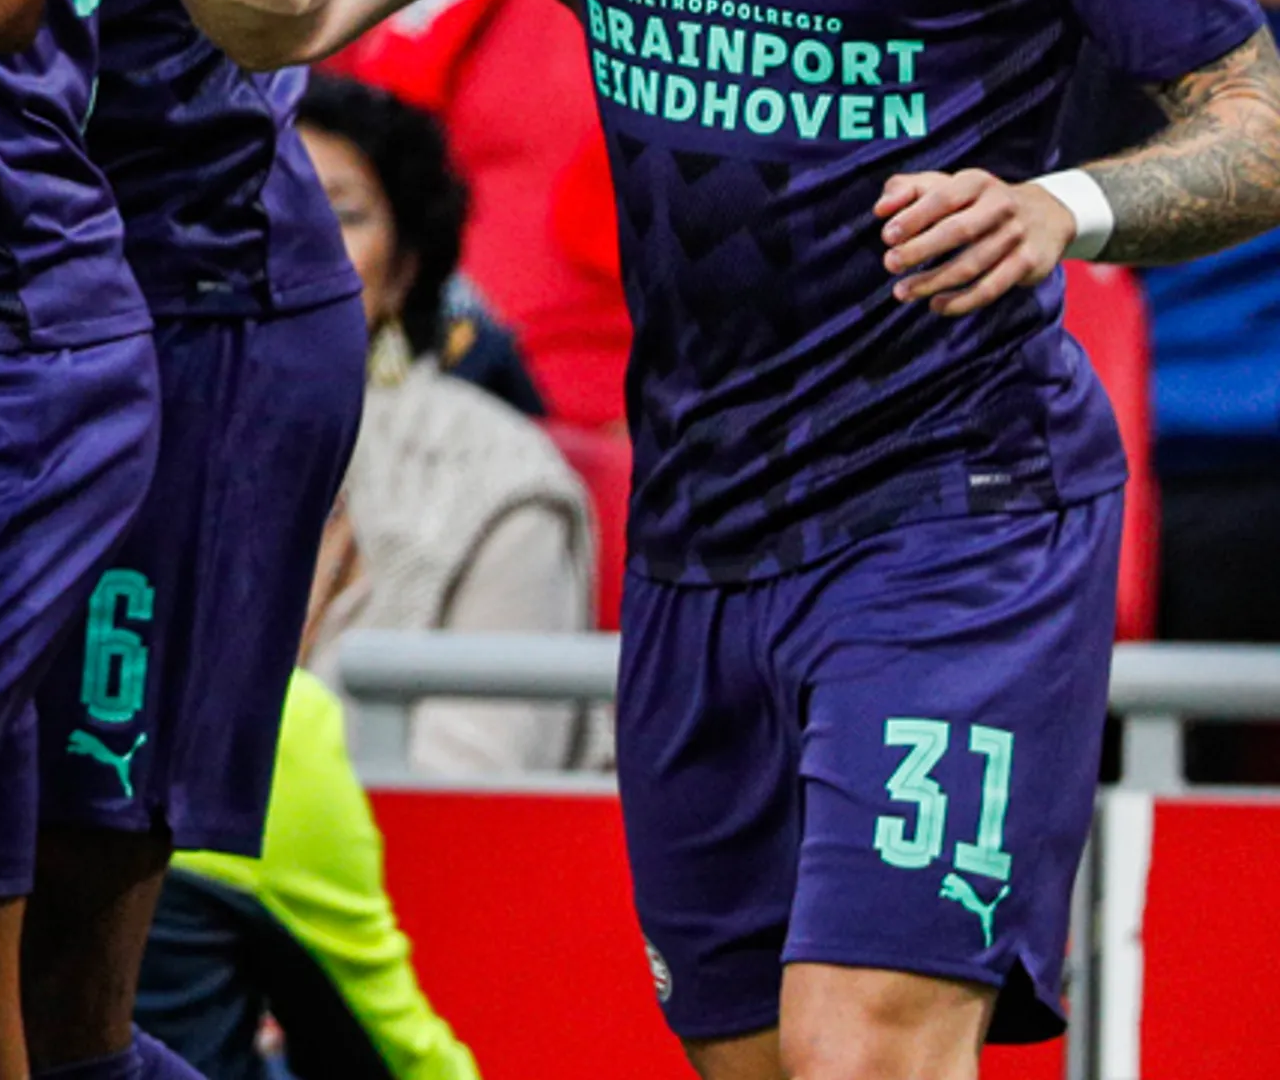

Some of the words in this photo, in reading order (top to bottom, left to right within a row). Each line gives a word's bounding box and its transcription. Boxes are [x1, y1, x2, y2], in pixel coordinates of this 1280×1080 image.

[592, 47, 928, 142] EINDHOVEN
[81, 569, 154, 723] 6
[874, 717, 1014, 880] 31
